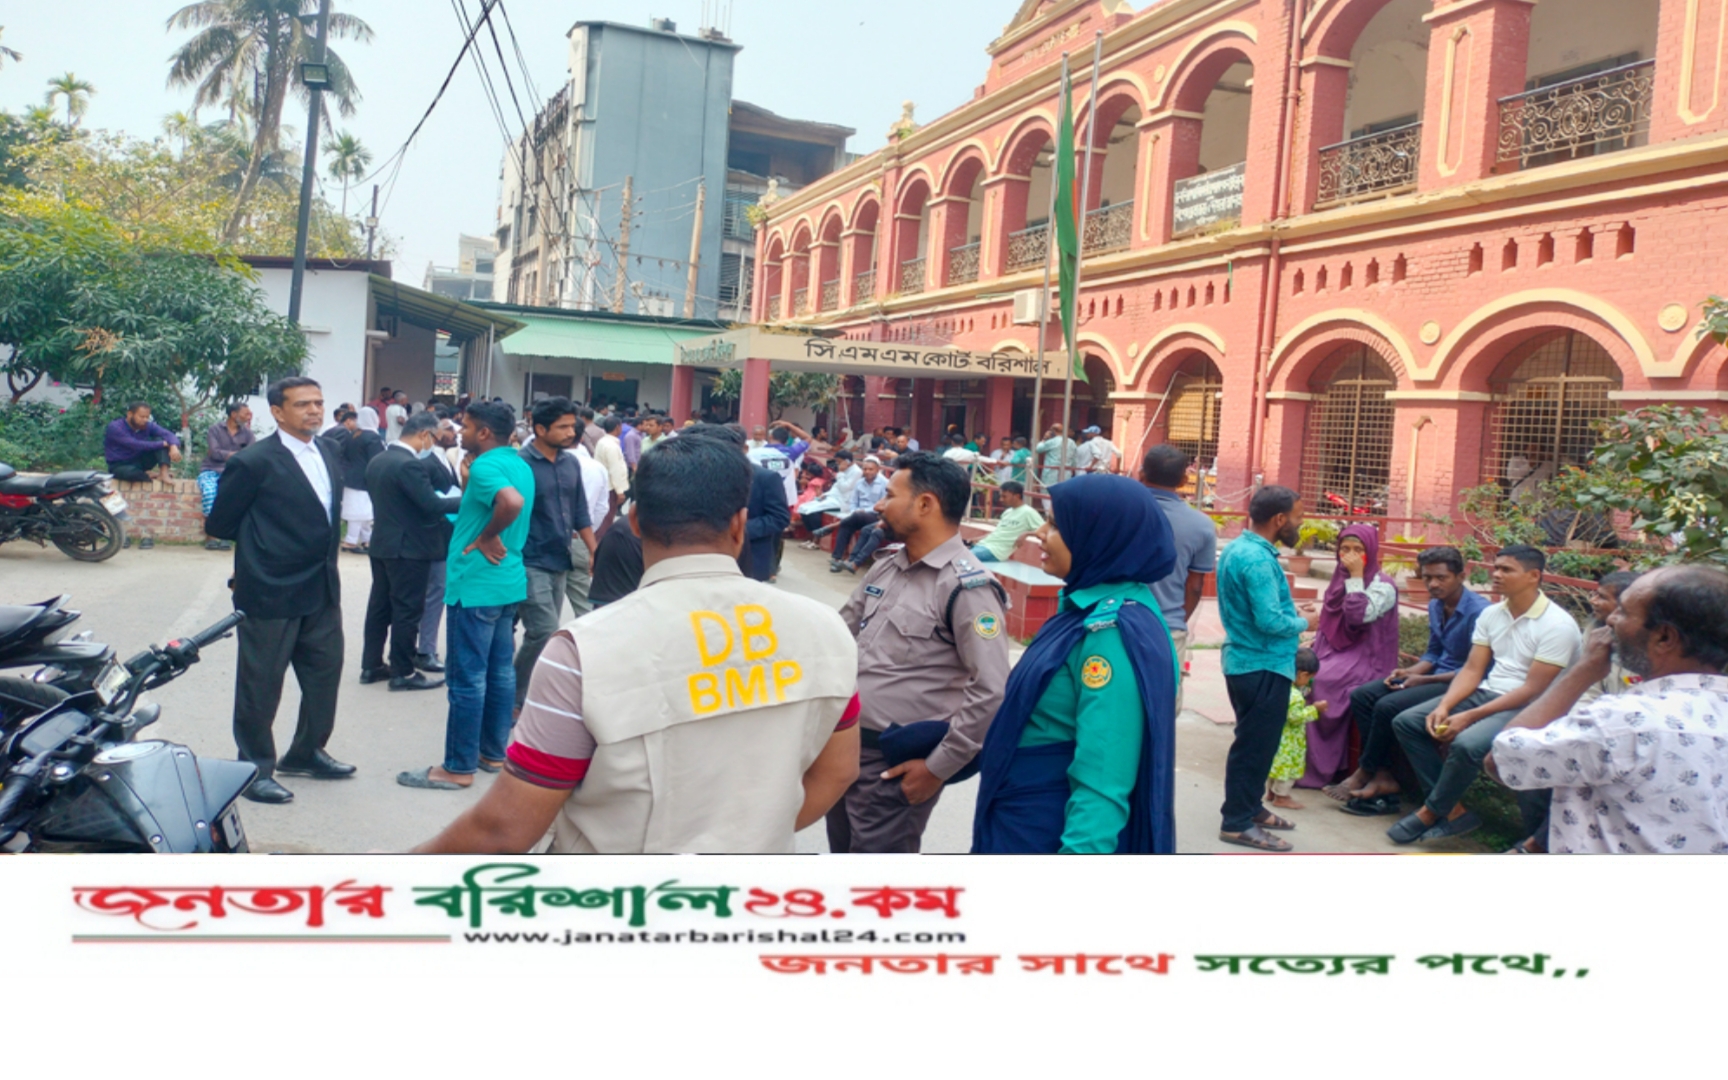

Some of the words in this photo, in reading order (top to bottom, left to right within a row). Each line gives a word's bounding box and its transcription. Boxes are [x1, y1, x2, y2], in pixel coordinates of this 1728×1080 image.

[922, 350, 971, 369] কোর্ট
[974, 352, 1052, 375] বরিশাল
[689, 603, 779, 668] DB
[687, 659, 803, 715] BMP
